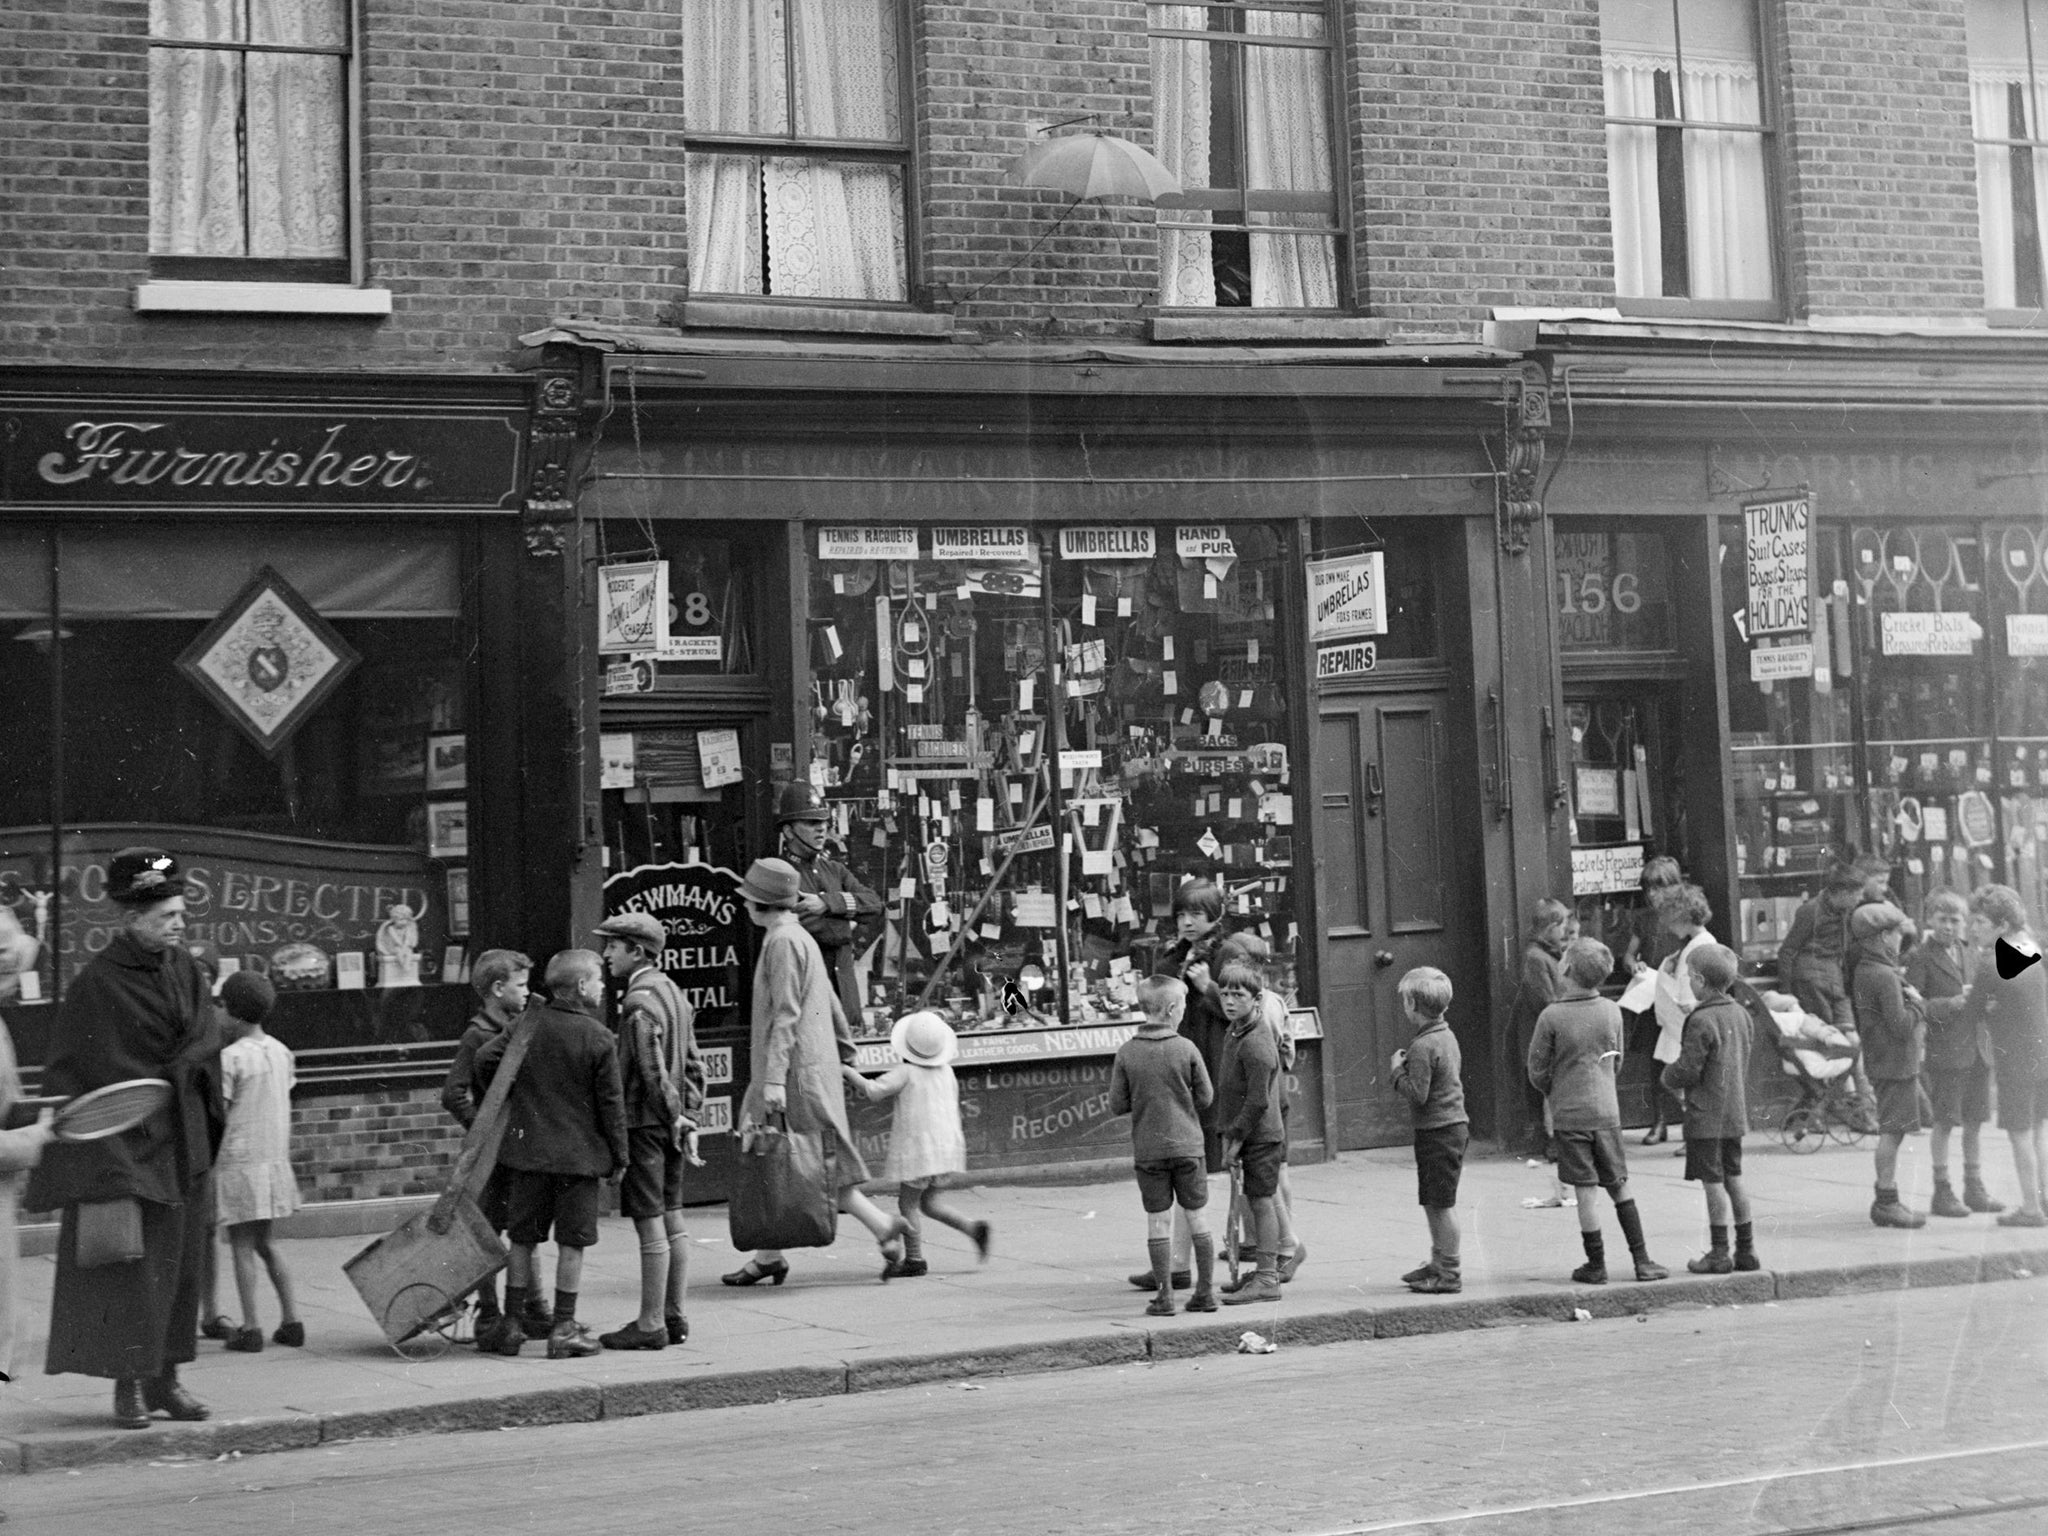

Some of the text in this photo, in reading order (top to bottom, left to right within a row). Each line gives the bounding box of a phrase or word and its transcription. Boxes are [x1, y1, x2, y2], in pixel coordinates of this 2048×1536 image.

[38, 421, 433, 487] Furnisher.
[1747, 501, 1808, 537] TRUNKS
[824, 528, 914, 544] TENNIS RACQUETS
[935, 528, 1025, 546] UMBRELLAS
[1065, 530, 1149, 554] UMBRELLAS
[1179, 528, 1221, 540] HAND
[938, 548, 974, 558] Repaired
[1772, 535, 1806, 558] Cases
[1317, 571, 1370, 622] UMBRELLAS
[1558, 572, 1642, 614] 156
[1758, 583, 1795, 600] FOR THE
[1750, 595, 1808, 632] HOLIDAYS
[674, 639, 718, 647] RACKETS
[1319, 646, 1374, 676] REPAIRS
[1181, 759, 1244, 773] PURSES
[221, 870, 428, 922] ERECTED
[982, 1036, 1018, 1046] FANCY
